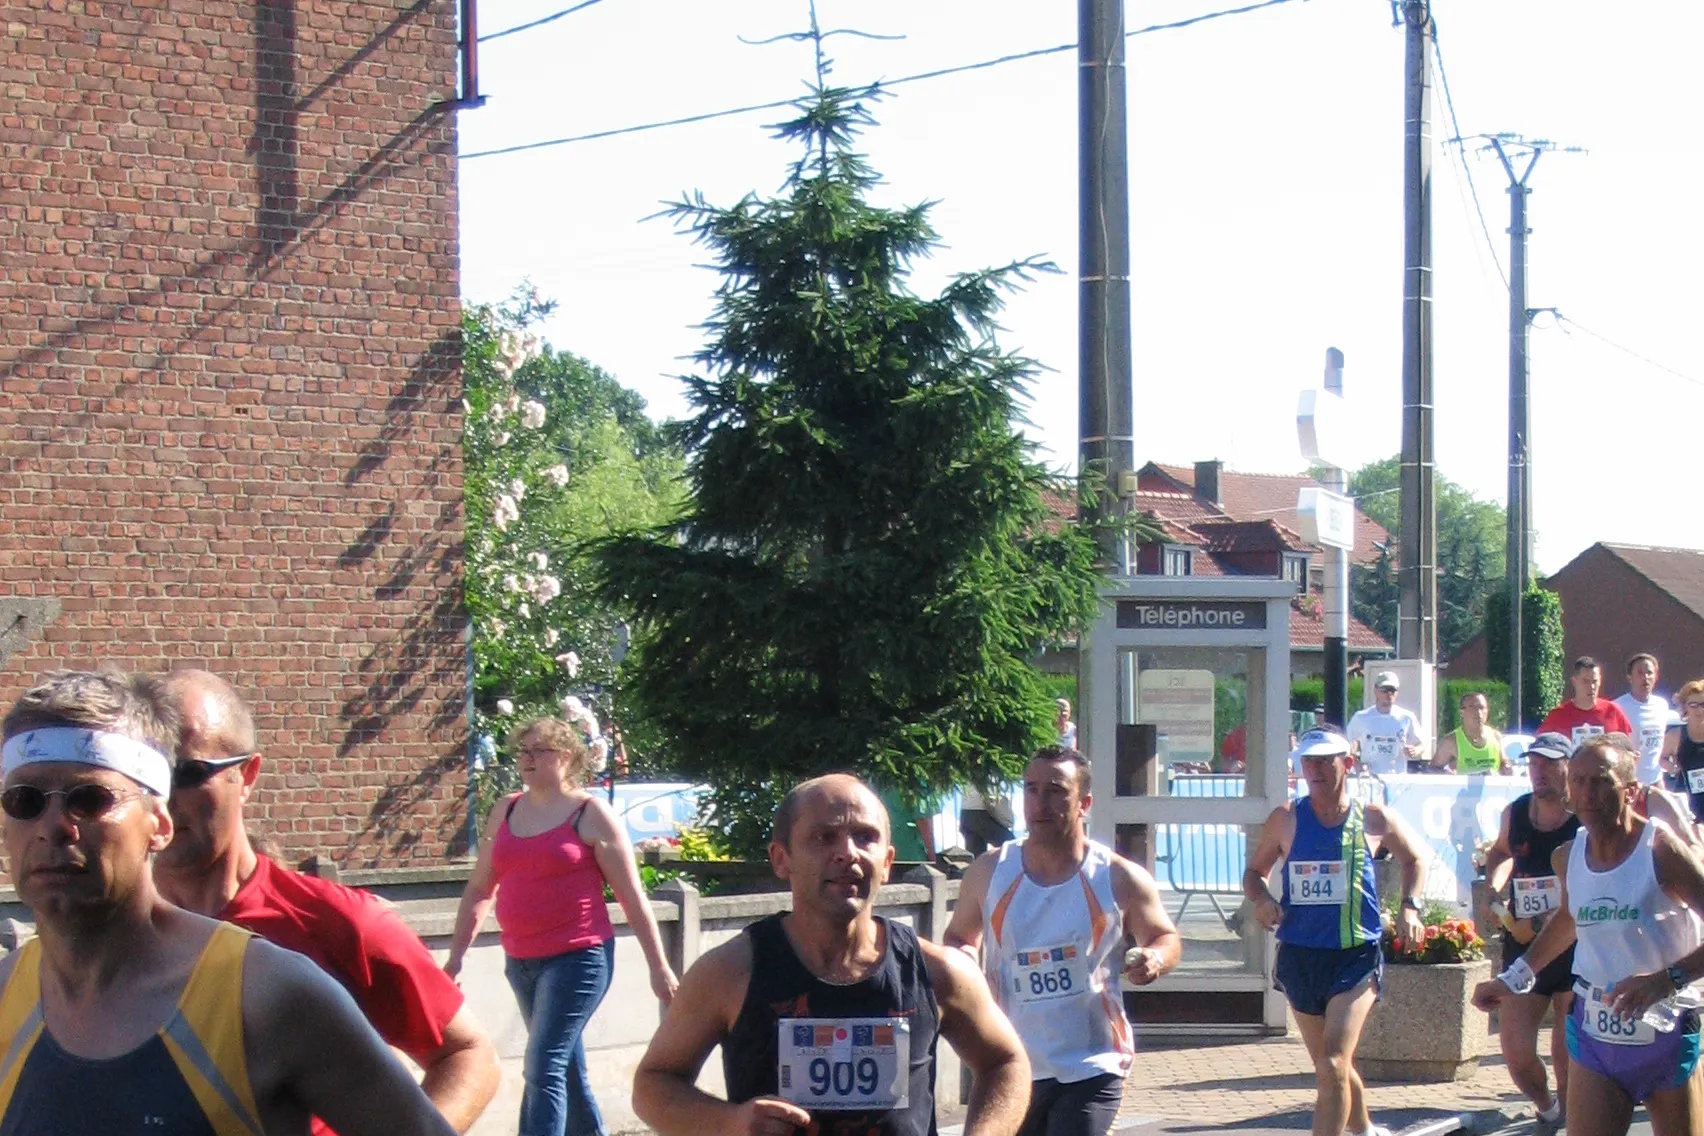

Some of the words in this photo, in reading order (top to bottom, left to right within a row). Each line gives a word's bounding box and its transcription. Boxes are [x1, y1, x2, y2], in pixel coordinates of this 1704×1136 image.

[1135, 605, 1245, 627] Téléphone
[1302, 880, 1333, 897] 844
[1523, 894, 1549, 911] 851
[1577, 903, 1639, 922] McBride
[1030, 968, 1072, 994] 868
[1597, 1010, 1636, 1036] 883
[809, 1057, 879, 1096] 909
